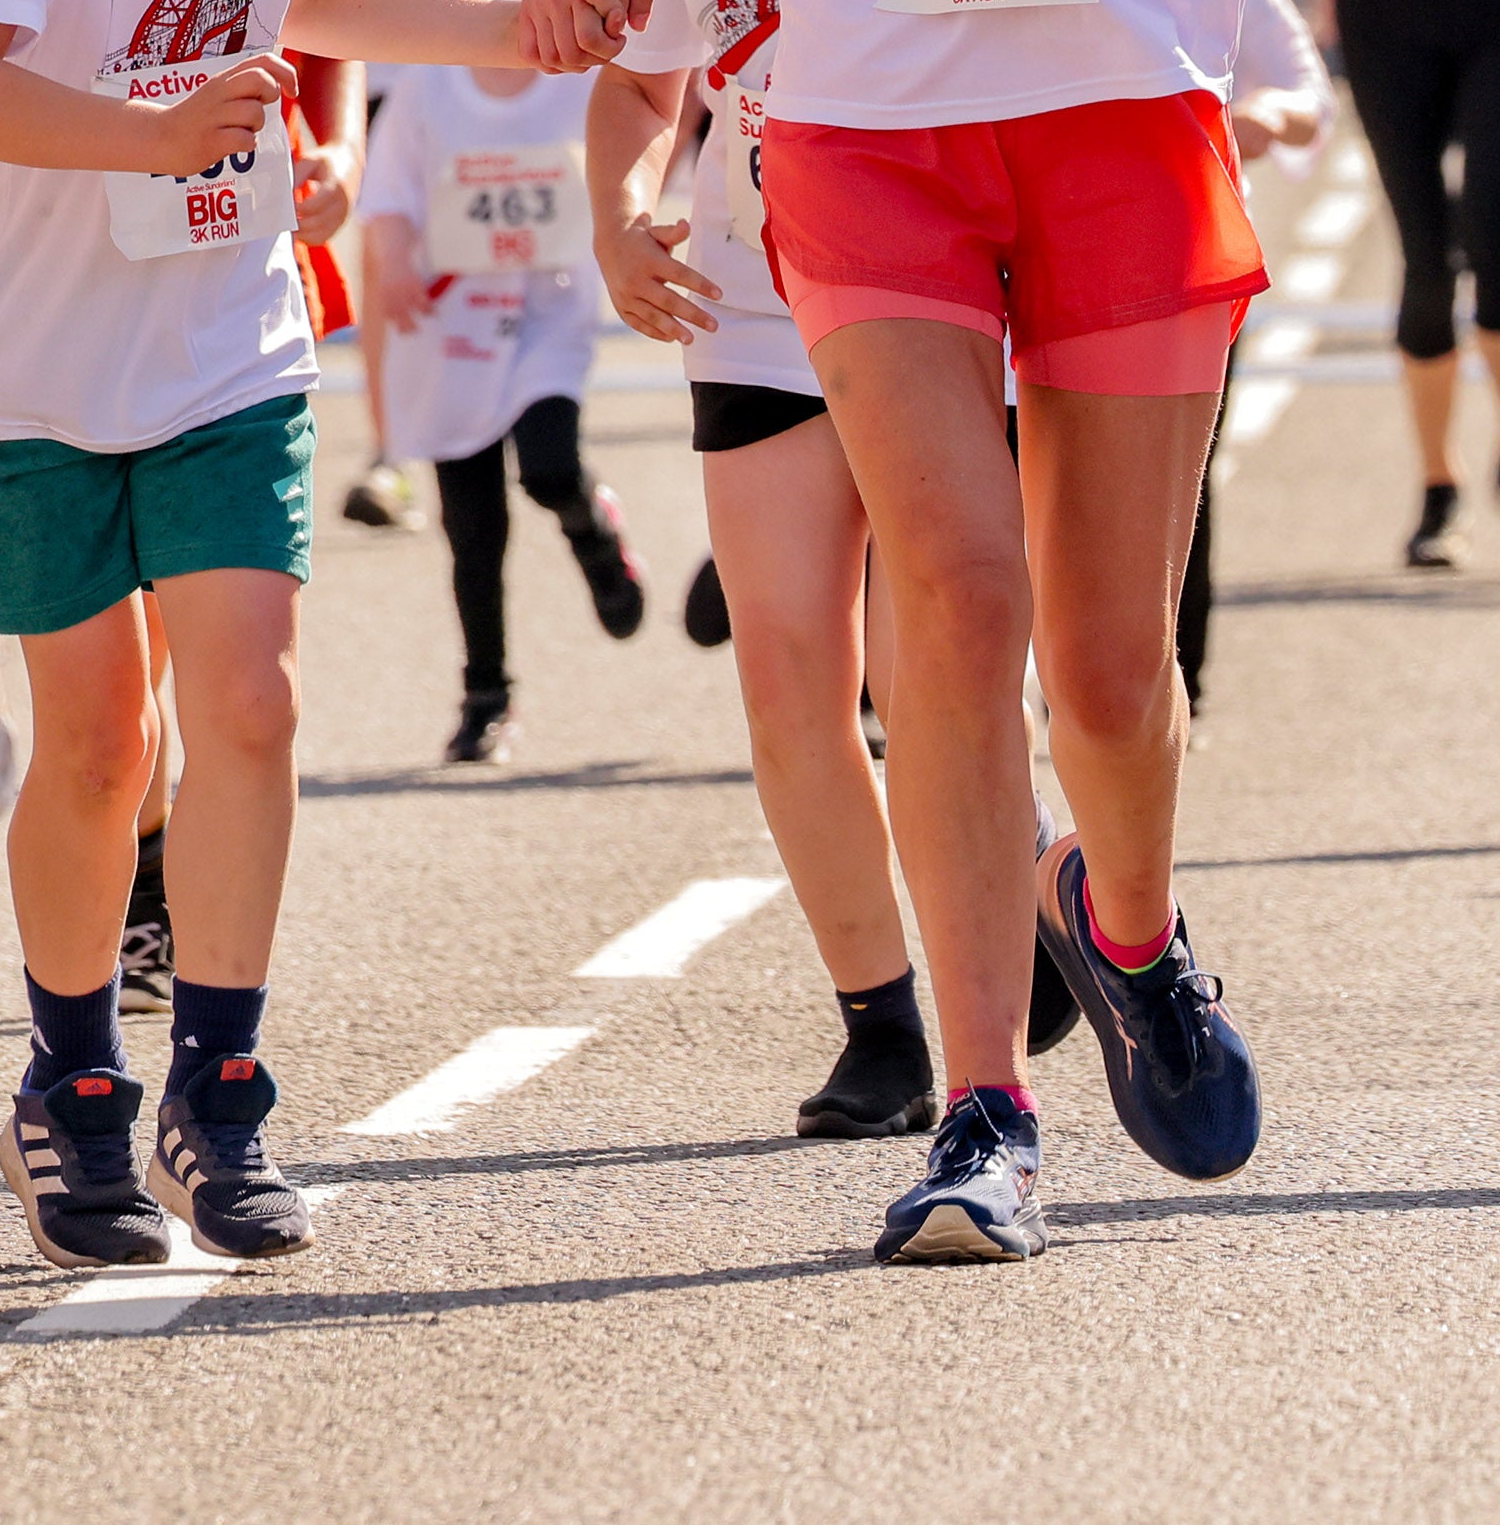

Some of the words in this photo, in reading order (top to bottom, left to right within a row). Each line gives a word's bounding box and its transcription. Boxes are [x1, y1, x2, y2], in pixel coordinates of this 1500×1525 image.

[127, 70, 208, 100] Active
[186, 184, 204, 194] Active
[205, 179, 235, 191] Sunderland
[187, 189, 238, 227] BIG
[466, 187, 555, 225] 463
[190, 229, 210, 244] 3K
[212, 222, 240, 240] RUN
